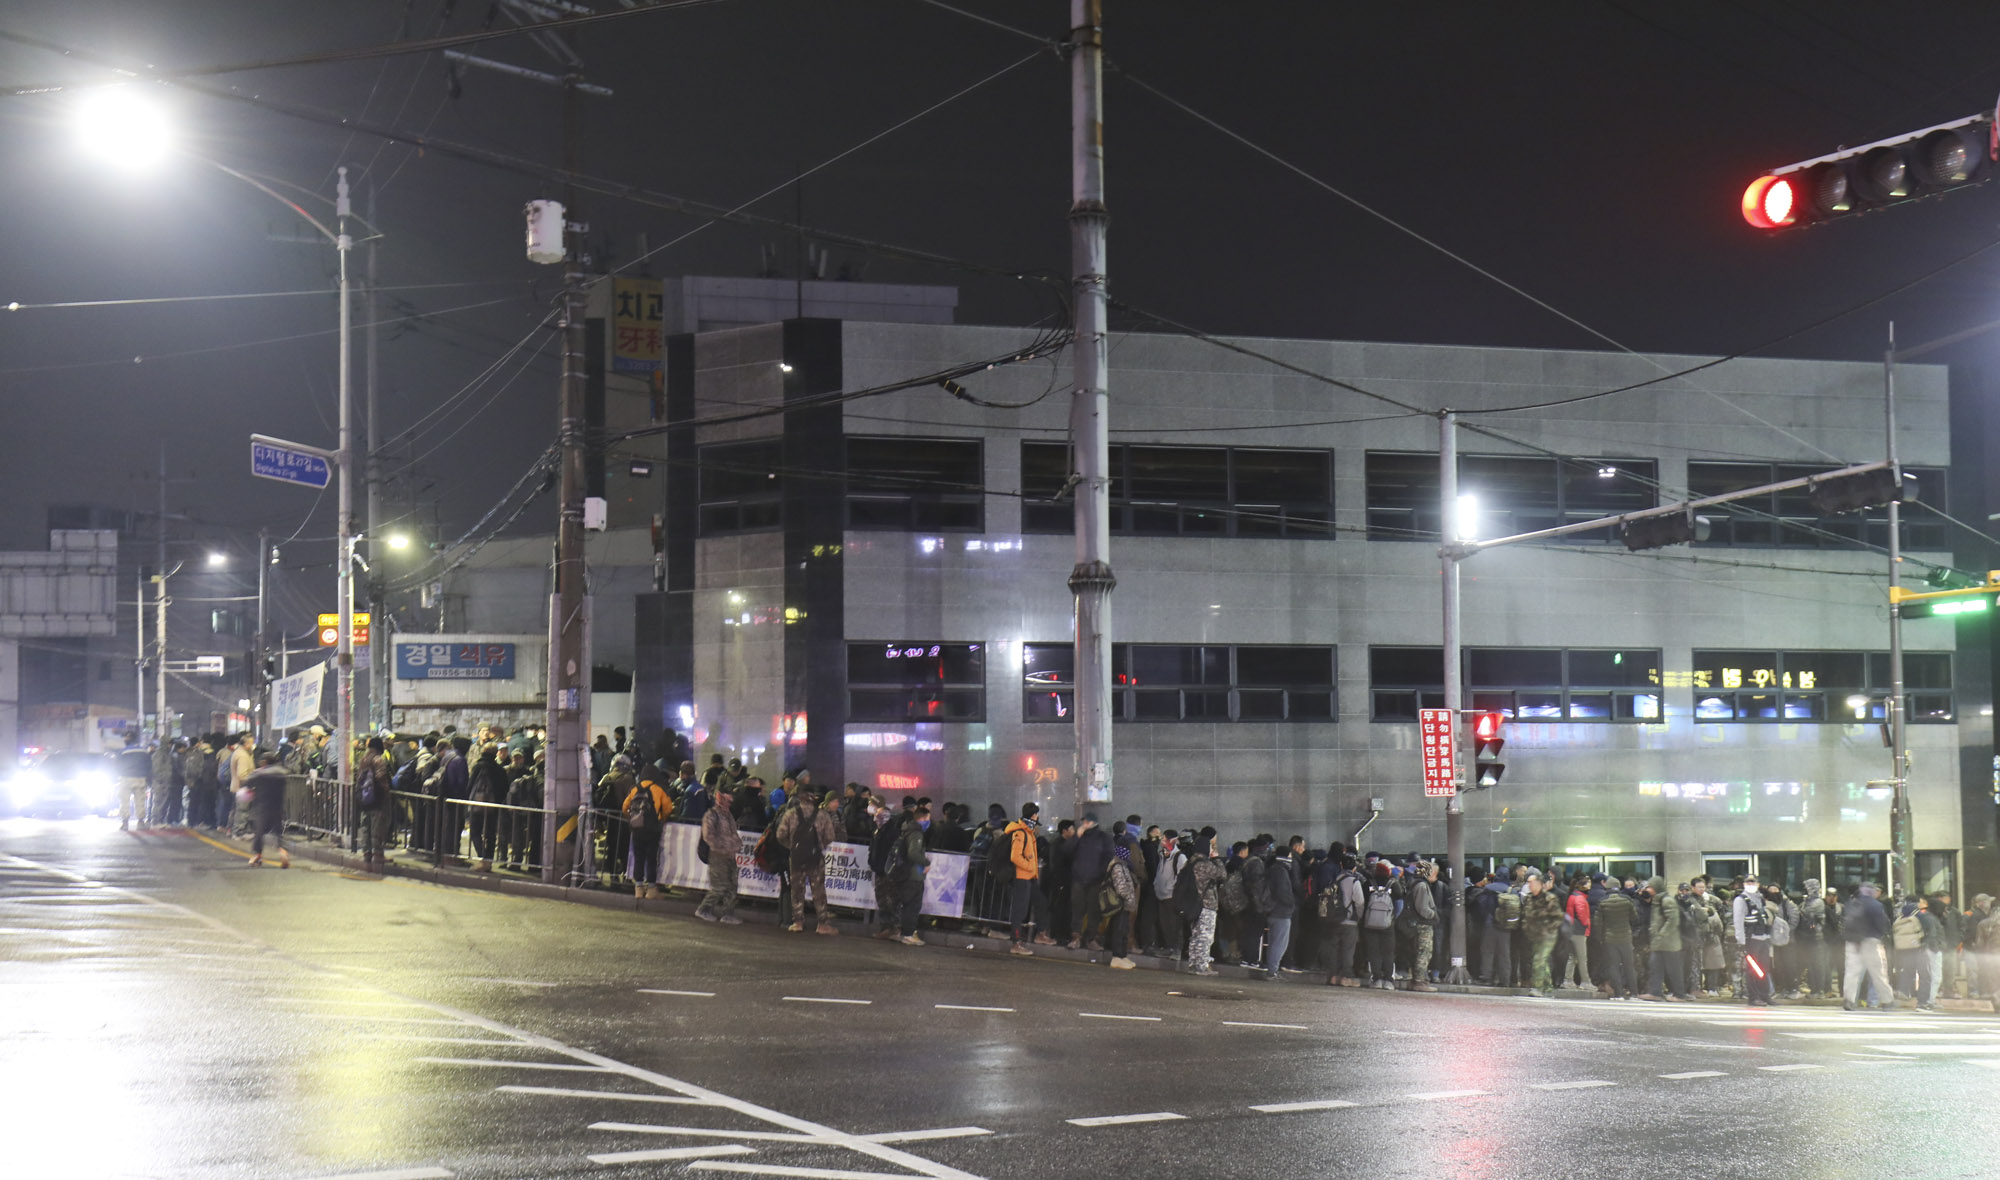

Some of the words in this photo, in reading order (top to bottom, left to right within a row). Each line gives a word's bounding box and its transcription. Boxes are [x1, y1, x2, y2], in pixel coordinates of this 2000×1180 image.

[405, 645, 451, 665] 경일
[460, 645, 506, 665] 석유
[825, 854, 860, 868] 外国人
